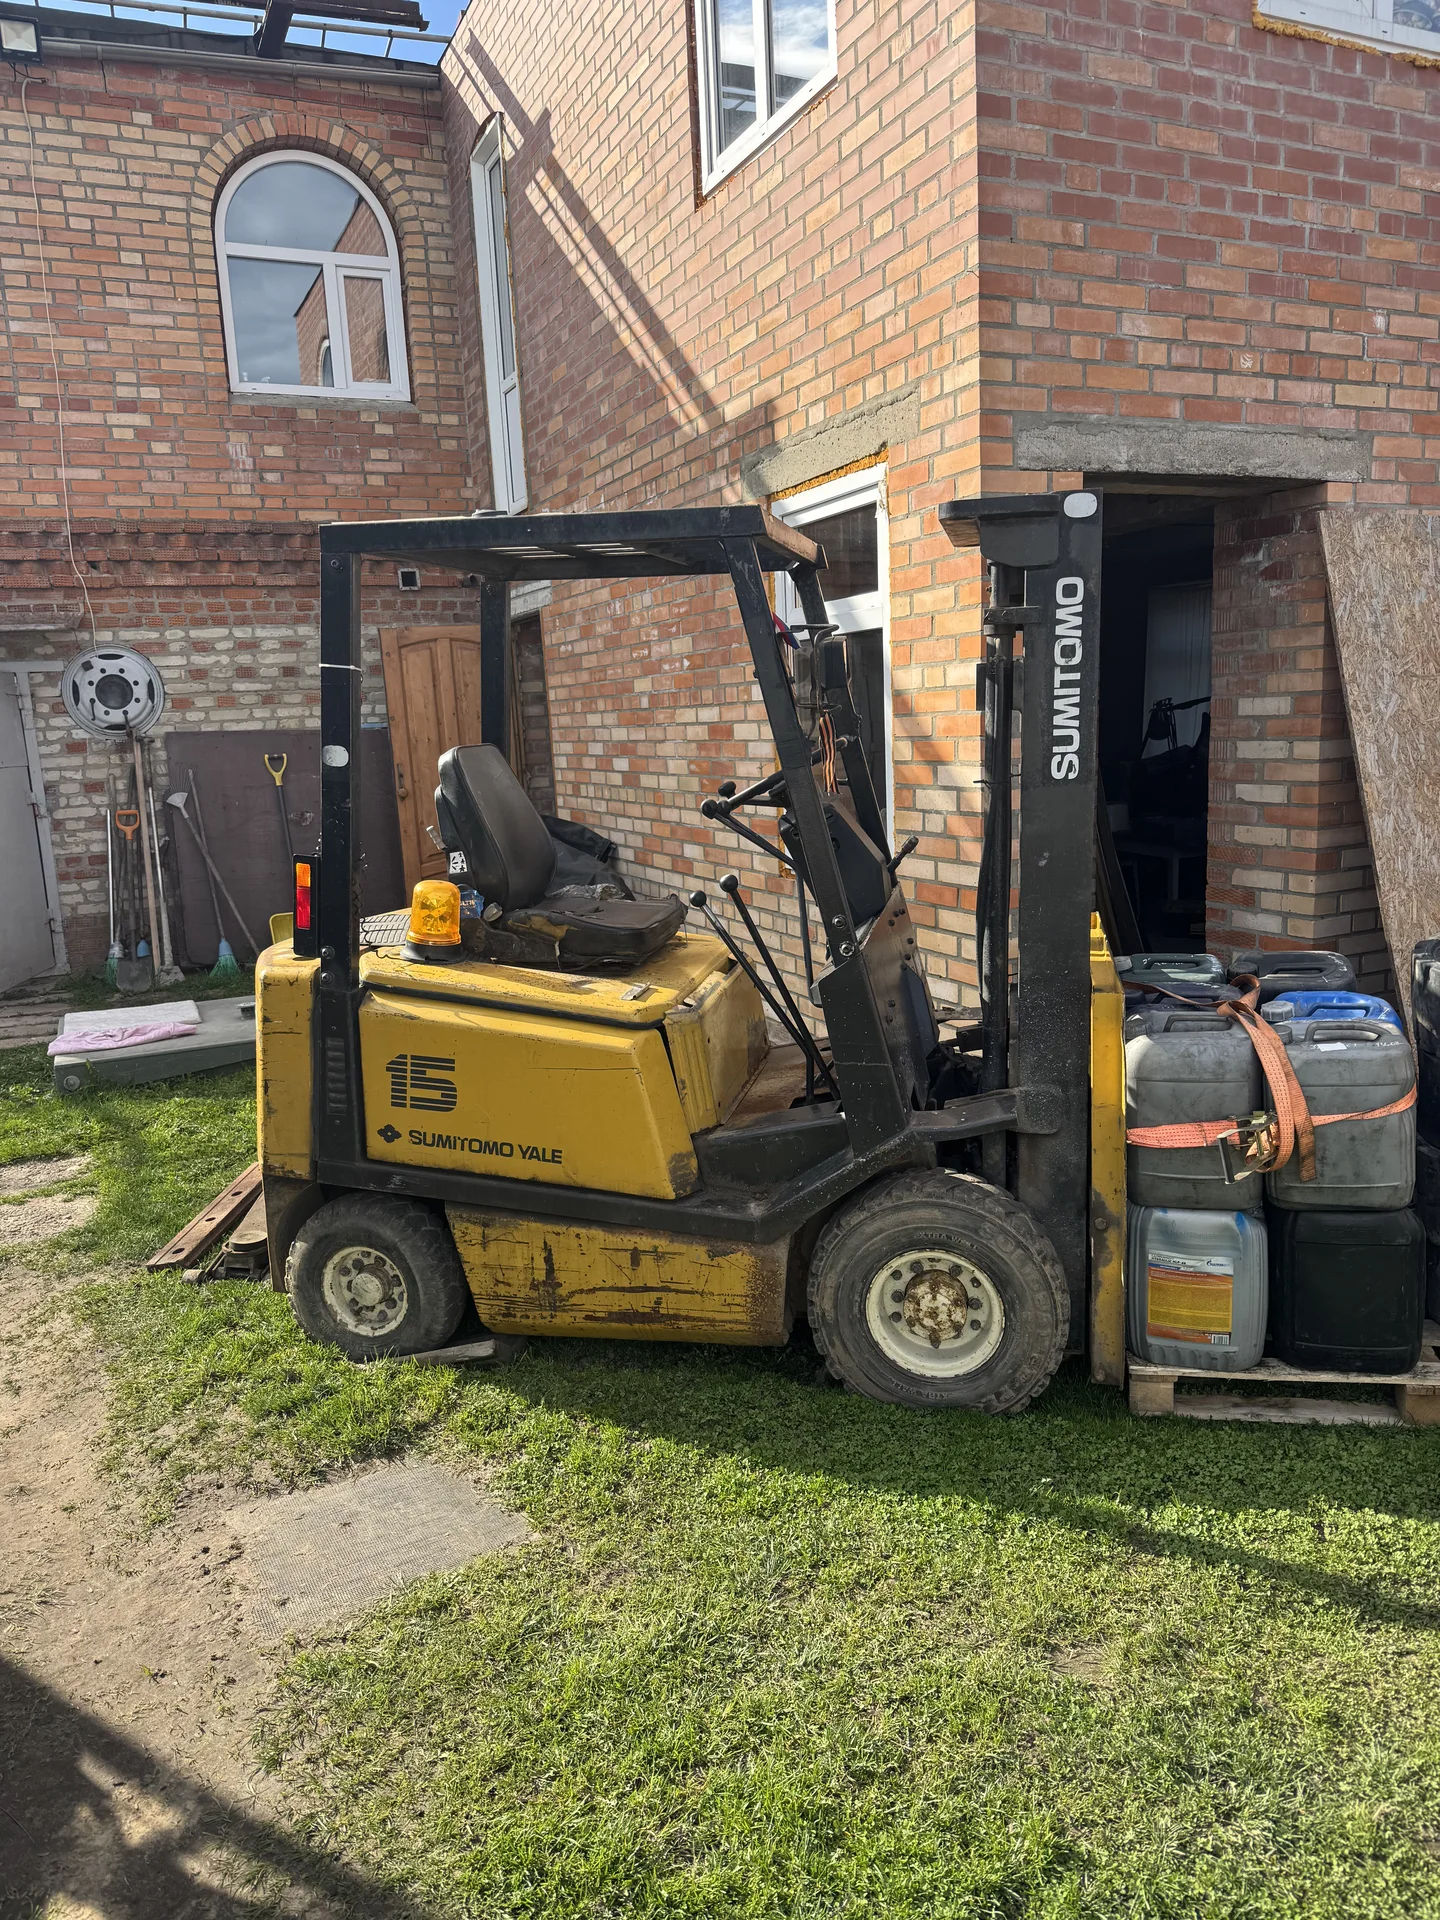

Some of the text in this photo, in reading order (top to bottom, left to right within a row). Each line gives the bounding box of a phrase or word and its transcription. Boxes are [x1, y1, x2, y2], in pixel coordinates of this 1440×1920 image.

[1051, 577, 1084, 780] SUMITOMO
[386, 1053, 458, 1112] 15
[408, 1129, 563, 1164] SUMITOMO YALE
